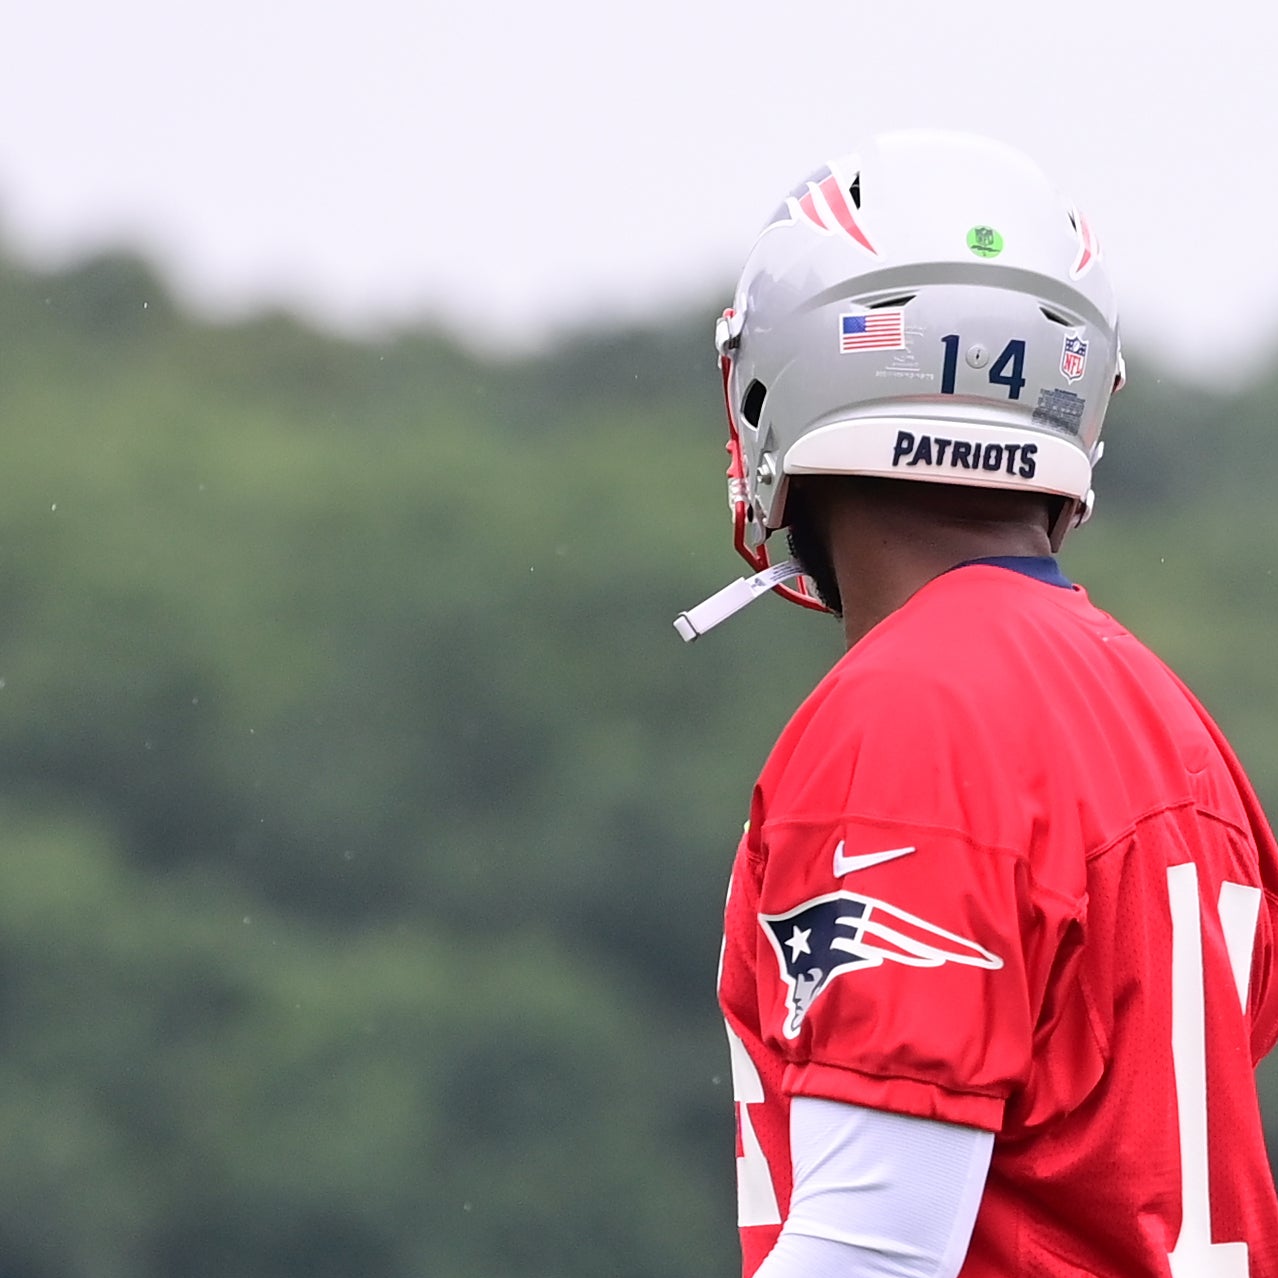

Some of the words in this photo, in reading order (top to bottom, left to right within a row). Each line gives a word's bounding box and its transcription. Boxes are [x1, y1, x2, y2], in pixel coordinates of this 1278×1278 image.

[941, 334, 1026, 400] 14
[1063, 354, 1083, 377] NFL
[892, 430, 1038, 479] PATRIOTS
